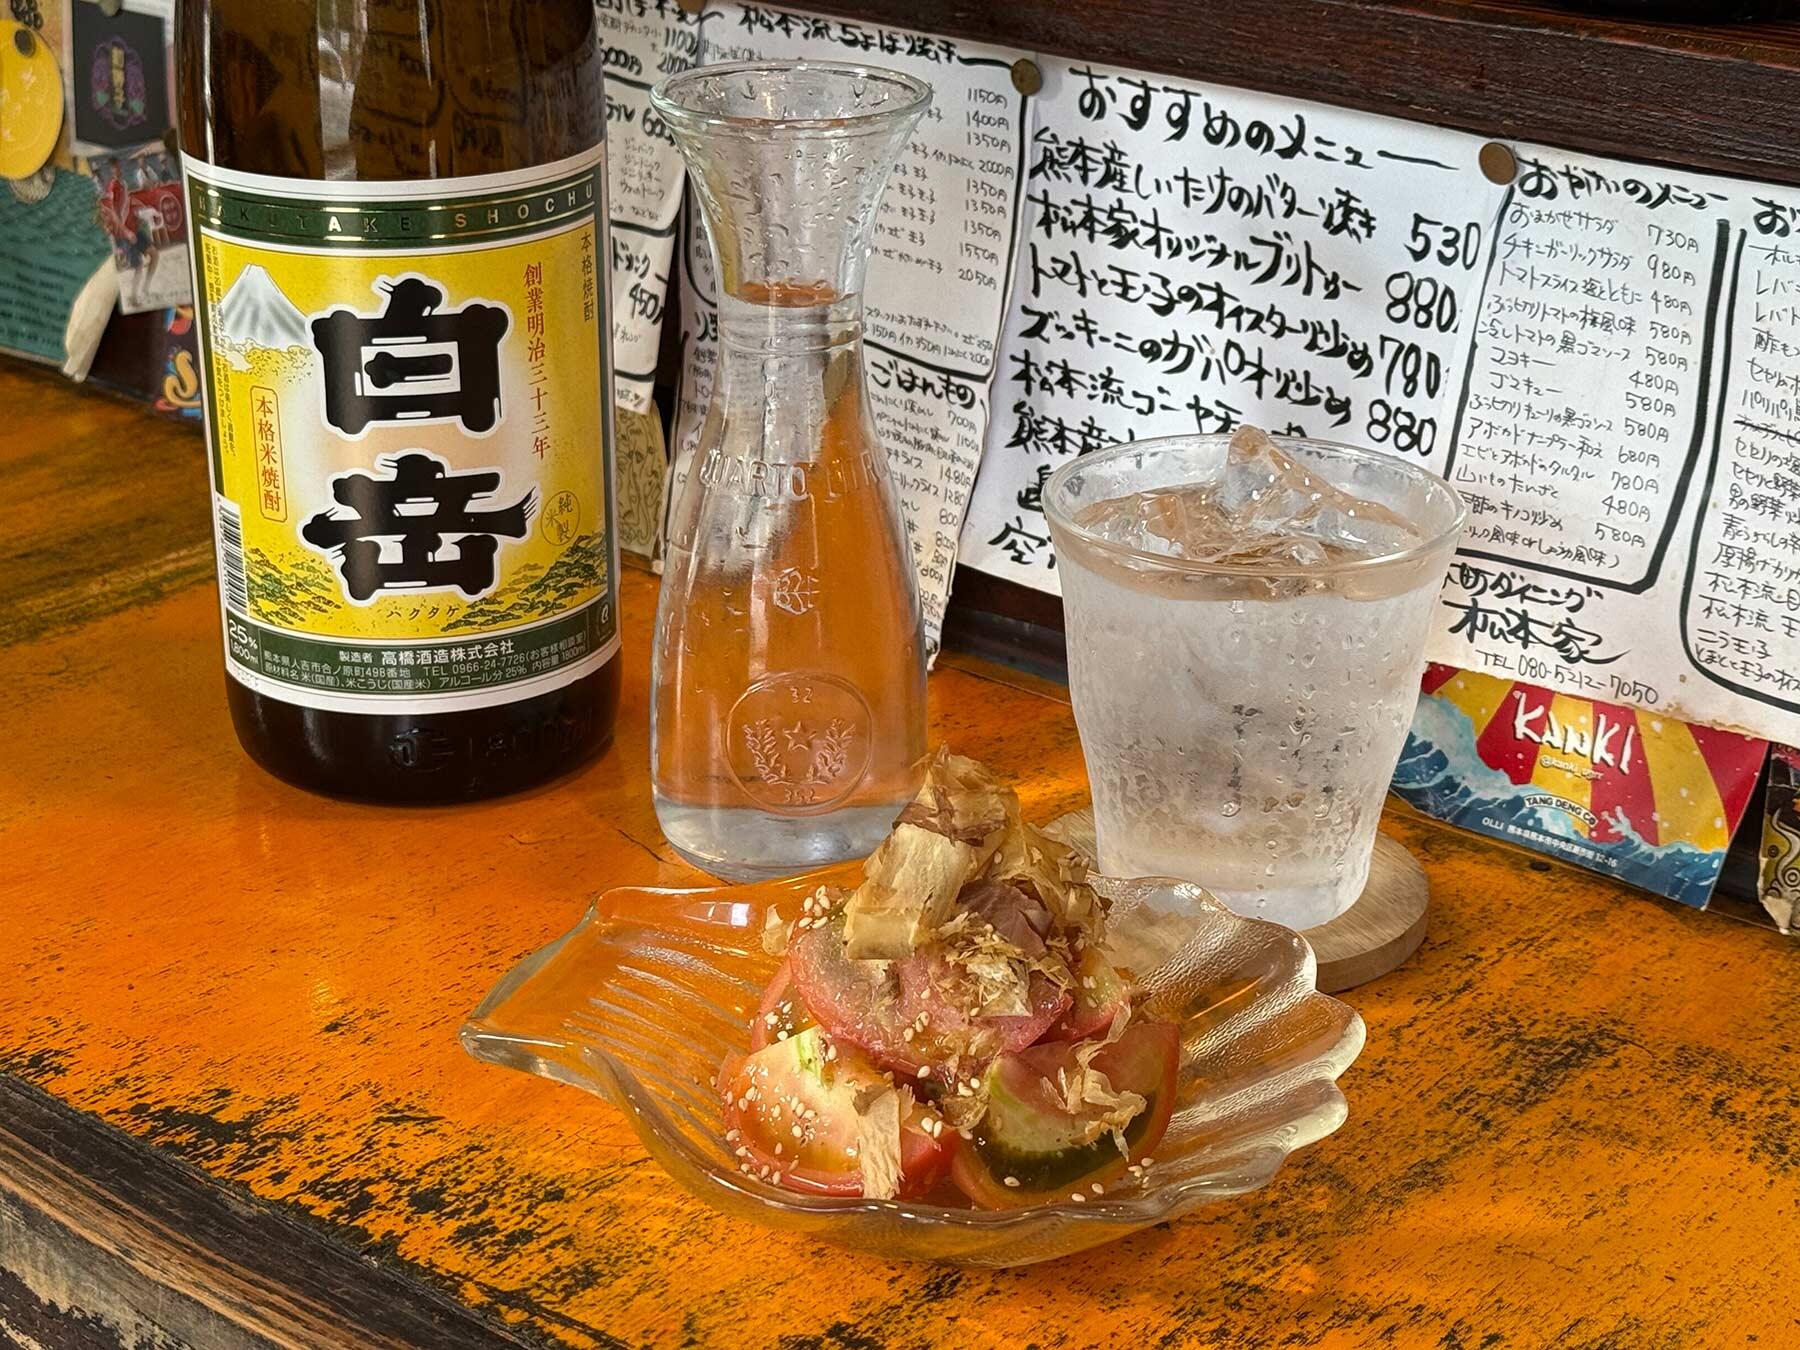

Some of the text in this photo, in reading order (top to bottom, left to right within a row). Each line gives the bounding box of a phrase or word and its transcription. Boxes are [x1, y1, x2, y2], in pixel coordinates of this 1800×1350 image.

[967, 87, 1008, 109] 1150円
[967, 110, 1009, 131] 1400円
[1069, 65, 1459, 171] おすすめのメニュー
[968, 132, 1011, 153] 1350円
[979, 160, 1014, 181] 2000円
[967, 178, 1008, 201] 1350円
[1029, 127, 1481, 270] 熊本産しいたけのバター焼き 530
[199, 182, 594, 233] HAKUTAKE SHOCHU
[966, 200, 1006, 219] 1350円
[964, 220, 1001, 240] 1350円
[1510, 202, 1699, 253] おまかせサラダ 730円
[959, 242, 999, 265] 1550円
[1503, 233, 1696, 287] チキンガーリックサラダ 980円
[580, 231, 596, 322] 本格焼酎
[958, 268, 997, 290] 2050円
[1650, 291, 1692, 316] 480円
[1030, 243, 1441, 399] トマトと玉子のオイスター炒め 780
[1649, 321, 1692, 345] 580円
[523, 261, 552, 460] 創業明治三十三年
[1646, 346, 1688, 372] 580円
[871, 359, 975, 409] ごはんもの
[1629, 370, 1679, 396] 480円
[1625, 392, 1676, 417] 580円
[948, 410, 977, 434] 700円
[1366, 399, 1437, 456] 880
[1625, 417, 1669, 443] 580円
[299, 278, 540, 603] 白岳
[255, 395, 283, 513] 本格米焼酎
[1618, 446, 1660, 468] 680円
[1611, 472, 1659, 494] 780円
[1602, 495, 1650, 522] 480円
[1594, 523, 1645, 548] 580円
[386, 605, 460, 622] ハクタケ
[228, 618, 259, 650] 25%
[1443, 598, 1631, 664] 松本家
[338, 639, 515, 666] 製造者 高橋酒造株式会社
[423, 666, 448, 677] TEL
[439, 669, 503, 688] アルコール分
[505, 665, 528, 679] 25%
[1476, 650, 1658, 705] TEL 080-5212-7050
[1513, 690, 1635, 774] KANKI
[1482, 817, 1505, 830] OLLI
[1526, 797, 1596, 826] TANG DENG CO
